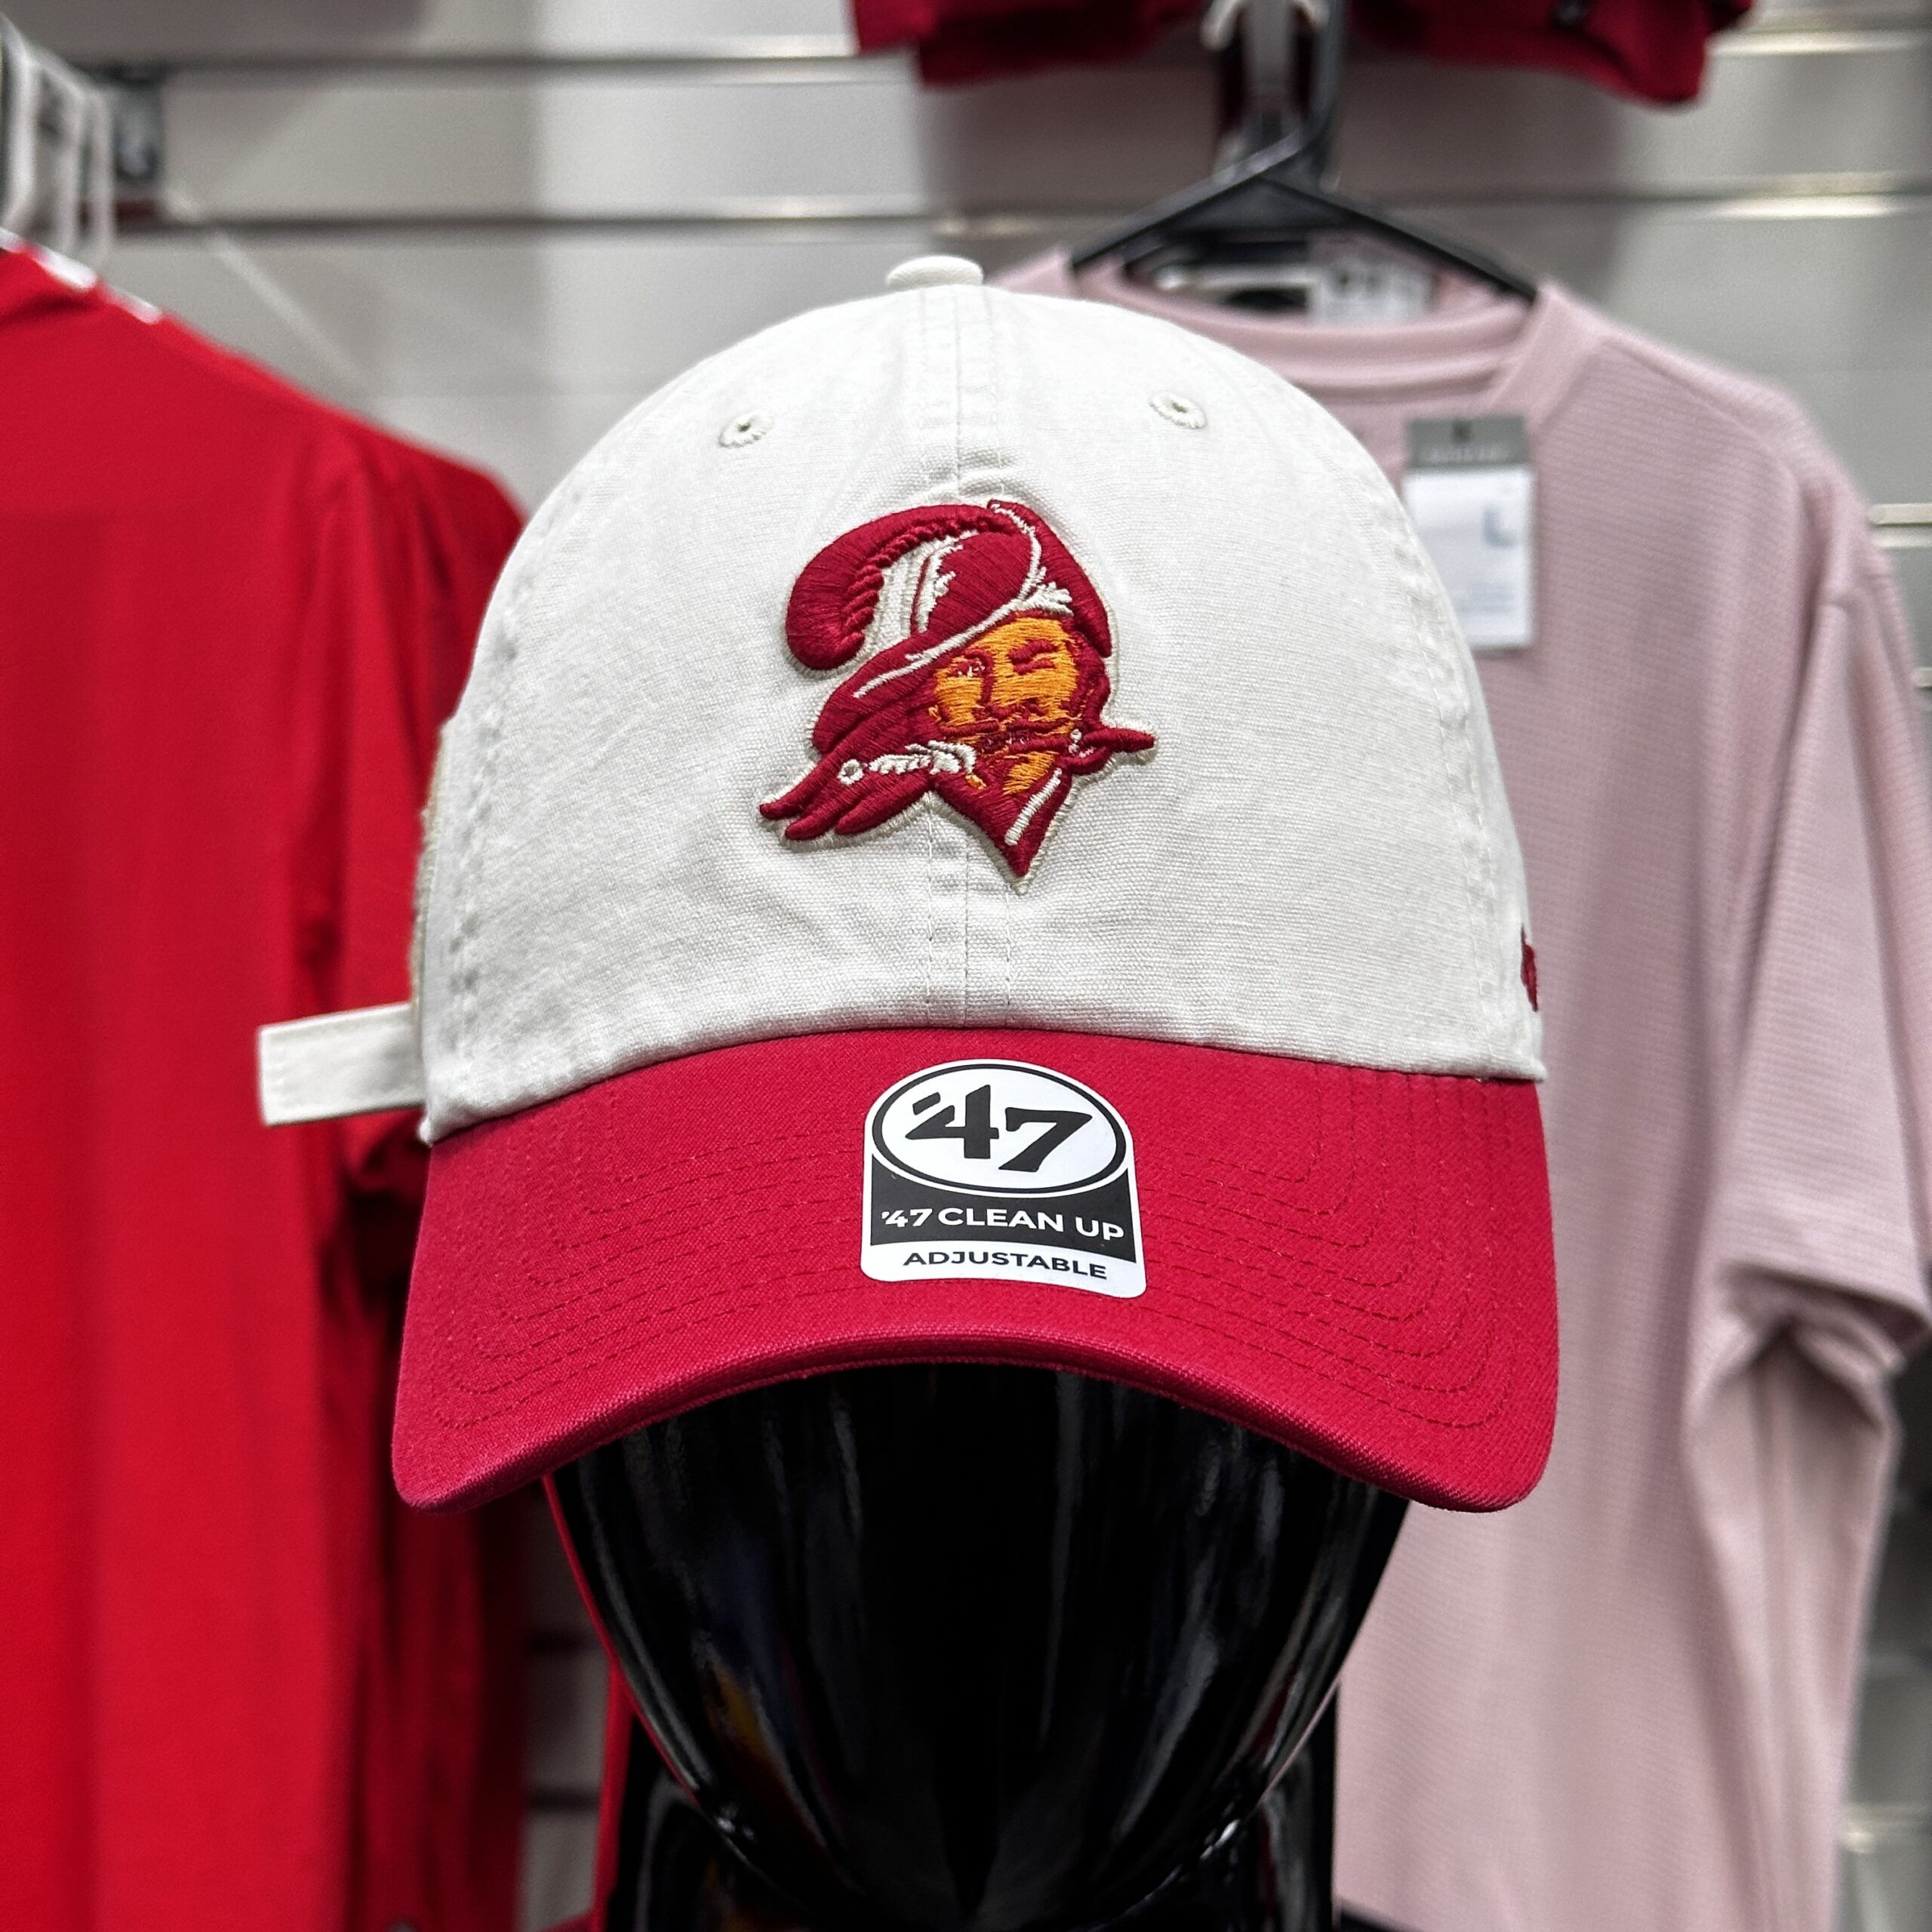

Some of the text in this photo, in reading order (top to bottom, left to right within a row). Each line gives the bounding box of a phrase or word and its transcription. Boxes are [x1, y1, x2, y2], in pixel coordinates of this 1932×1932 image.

[905, 1084, 1093, 1173] '47
[881, 1208, 1124, 1241] '47 CLEAN UP
[903, 1251, 1107, 1280] ADJUSTABLE
